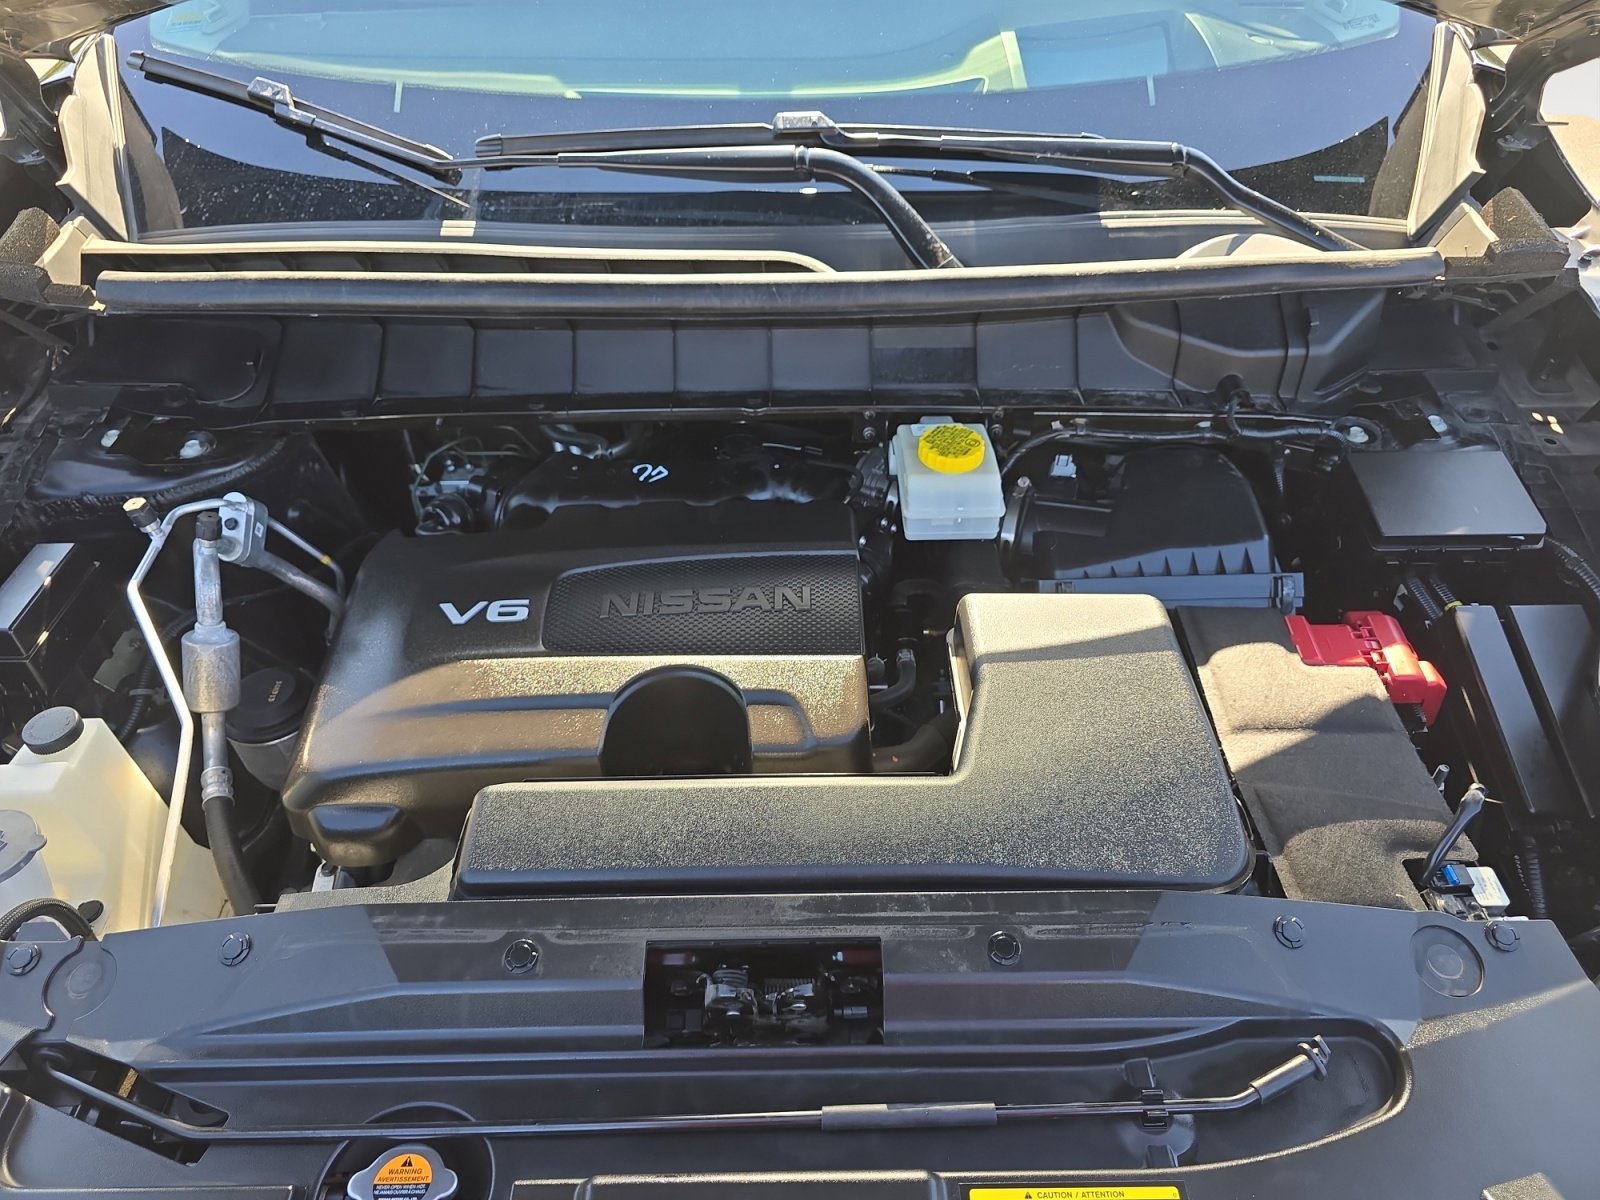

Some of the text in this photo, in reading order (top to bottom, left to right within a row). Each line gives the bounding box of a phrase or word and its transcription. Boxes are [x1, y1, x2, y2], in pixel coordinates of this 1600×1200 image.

[439, 599, 530, 625] V6
[599, 586, 812, 618] NISSAN
[1037, 1191, 1073, 1199] CAUTION
